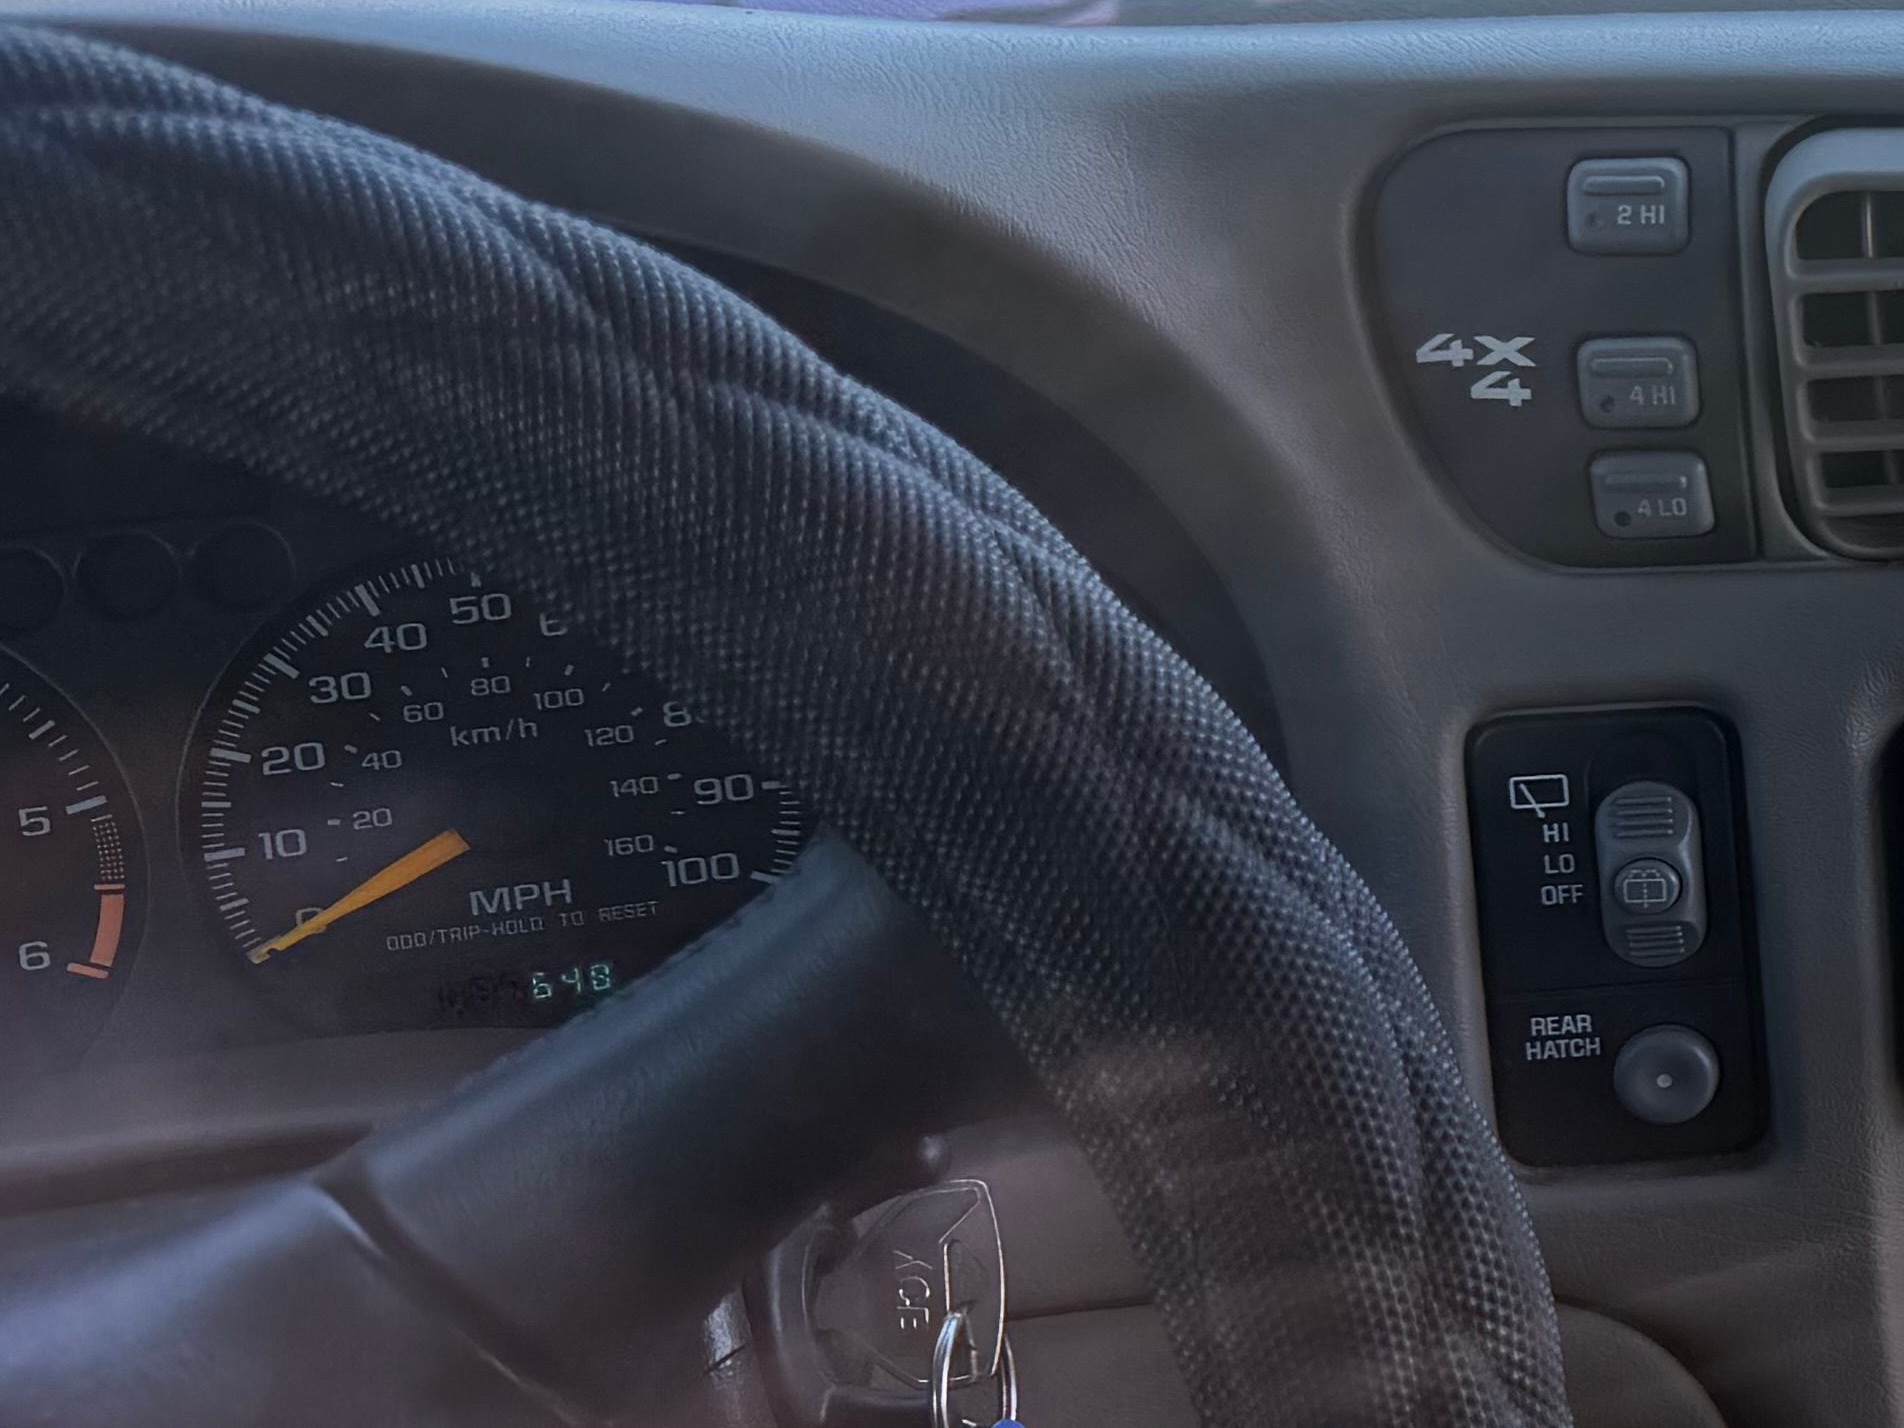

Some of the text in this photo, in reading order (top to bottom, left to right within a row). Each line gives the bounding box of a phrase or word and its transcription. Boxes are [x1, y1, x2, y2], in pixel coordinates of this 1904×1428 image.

[1616, 204, 1665, 225] 2 HI
[1630, 385, 1675, 405] 4 HI
[1638, 498, 1687, 517] 4 LO
[450, 593, 512, 624] 50
[539, 612, 568, 636] 6
[364, 623, 427, 653] 40
[308, 672, 371, 703] 30
[470, 675, 511, 696] 80
[533, 688, 584, 710] 100
[403, 702, 444, 722] 60
[662, 701, 704, 727] 8
[450, 718, 538, 746] km/h
[584, 724, 635, 747] 120
[261, 742, 325, 775] 20
[361, 750, 402, 769] 40
[610, 776, 660, 798] 140
[693, 774, 754, 806] 90
[18, 806, 51, 836] 5
[352, 808, 392, 830] 20
[258, 828, 307, 860] 10
[1542, 823, 1570, 843] HI
[605, 834, 655, 857] 160
[661, 852, 740, 888] 100
[1544, 854, 1575, 874] LO
[469, 878, 572, 916] MPH
[1540, 884, 1584, 906] OFF
[559, 911, 585, 927] TO
[598, 900, 659, 922] RESET
[18, 940, 51, 971] 6
[1531, 1014, 1592, 1037] REAR
[1526, 1038, 1601, 1060] HATCH
